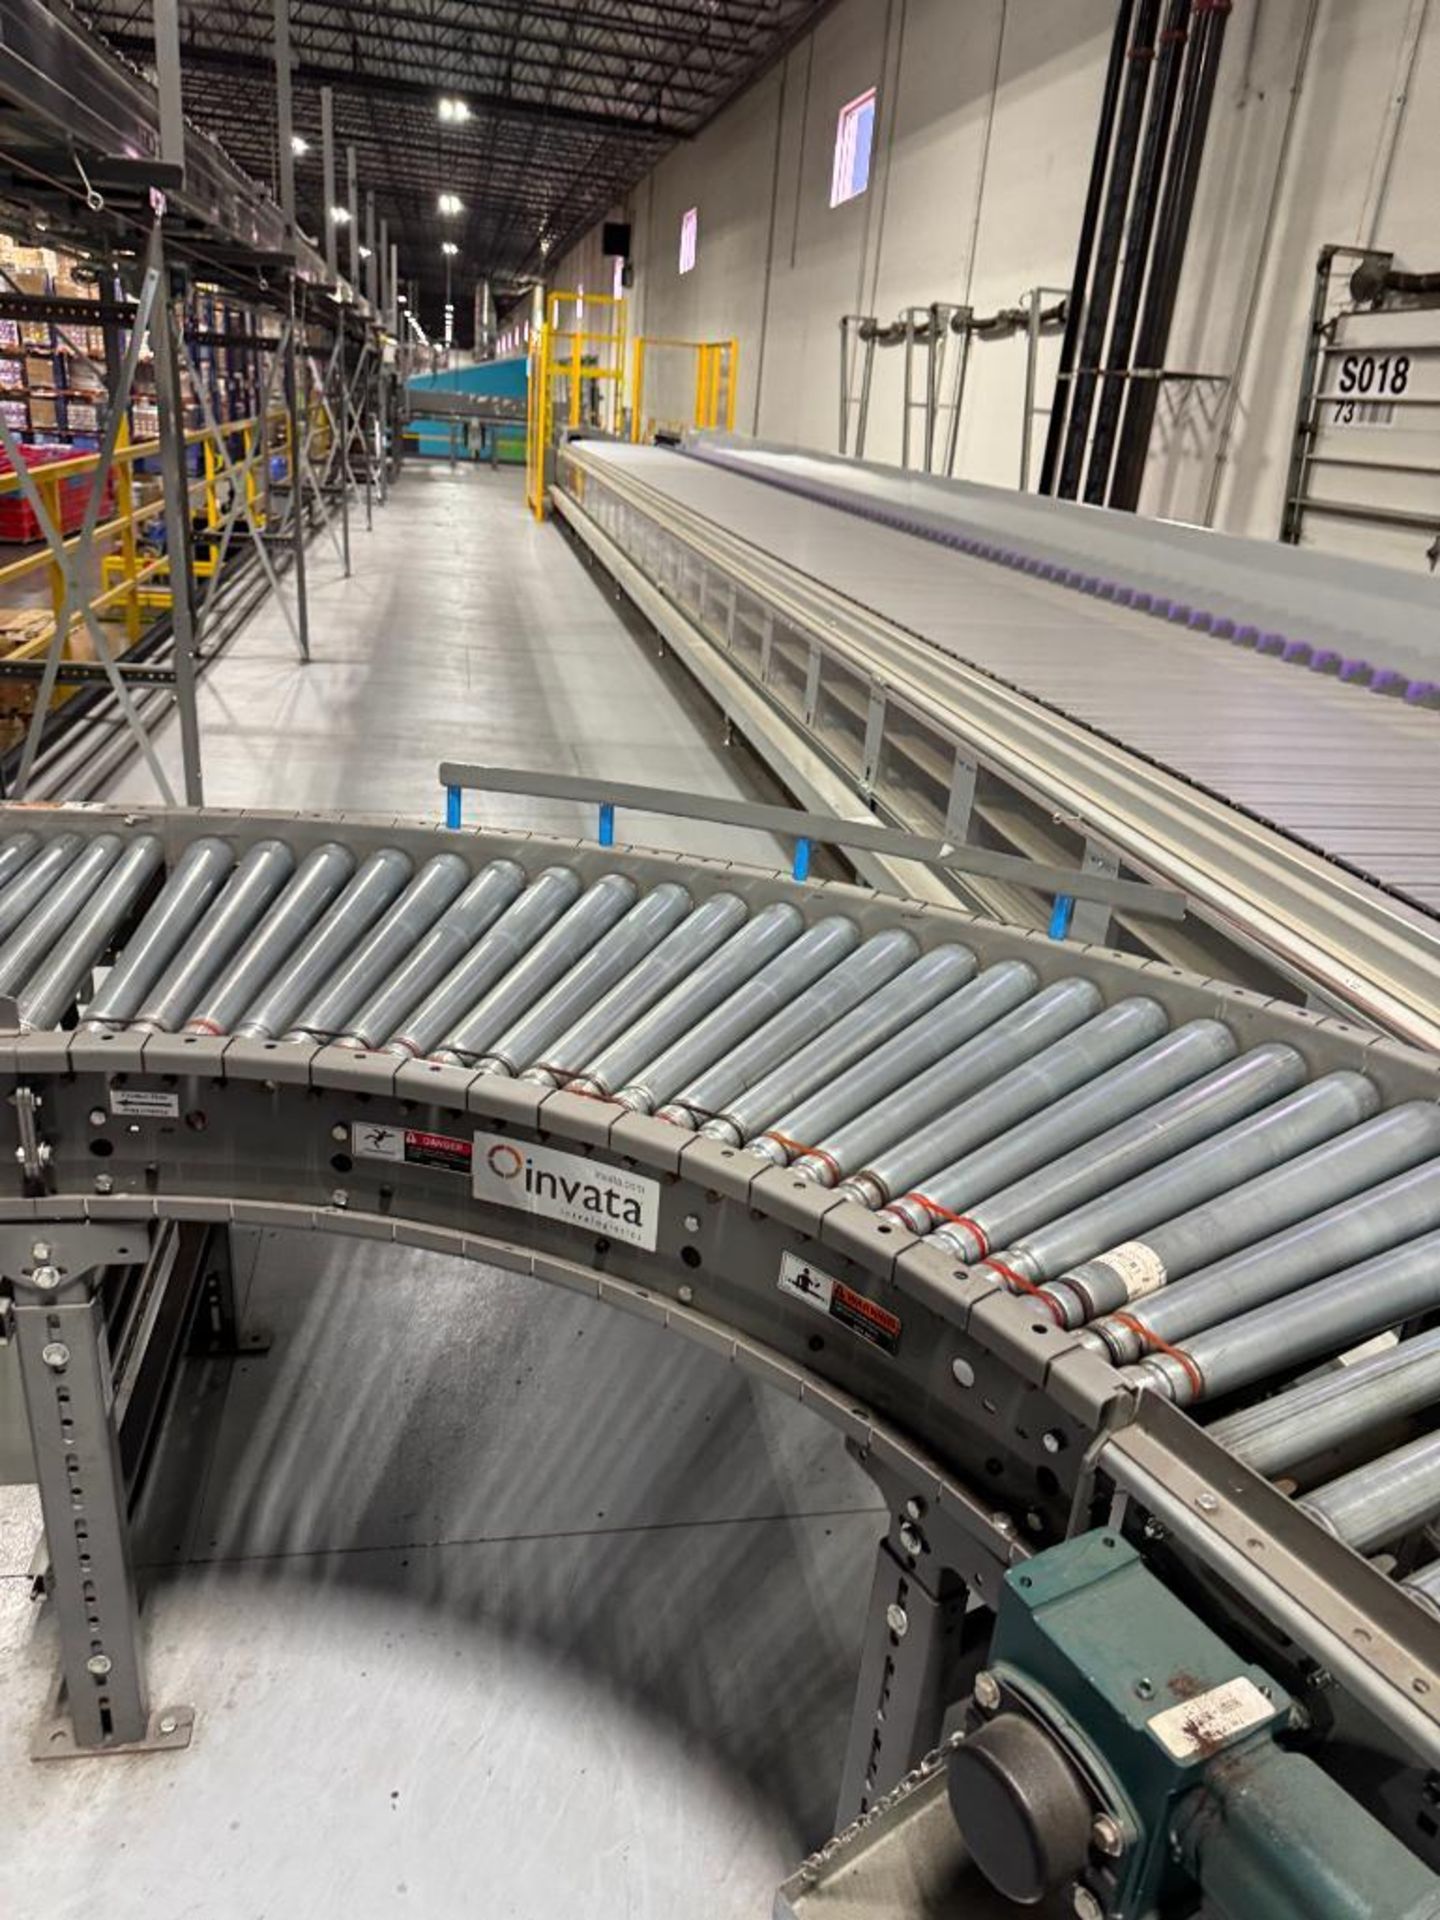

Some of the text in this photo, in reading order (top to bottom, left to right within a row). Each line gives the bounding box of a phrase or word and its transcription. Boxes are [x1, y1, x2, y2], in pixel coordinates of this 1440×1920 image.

[1339, 356, 1410, 394] S018
[1333, 400, 1355, 423] 73
[422, 1137, 464, 1151] DANGER
[525, 1158, 643, 1227] invata
